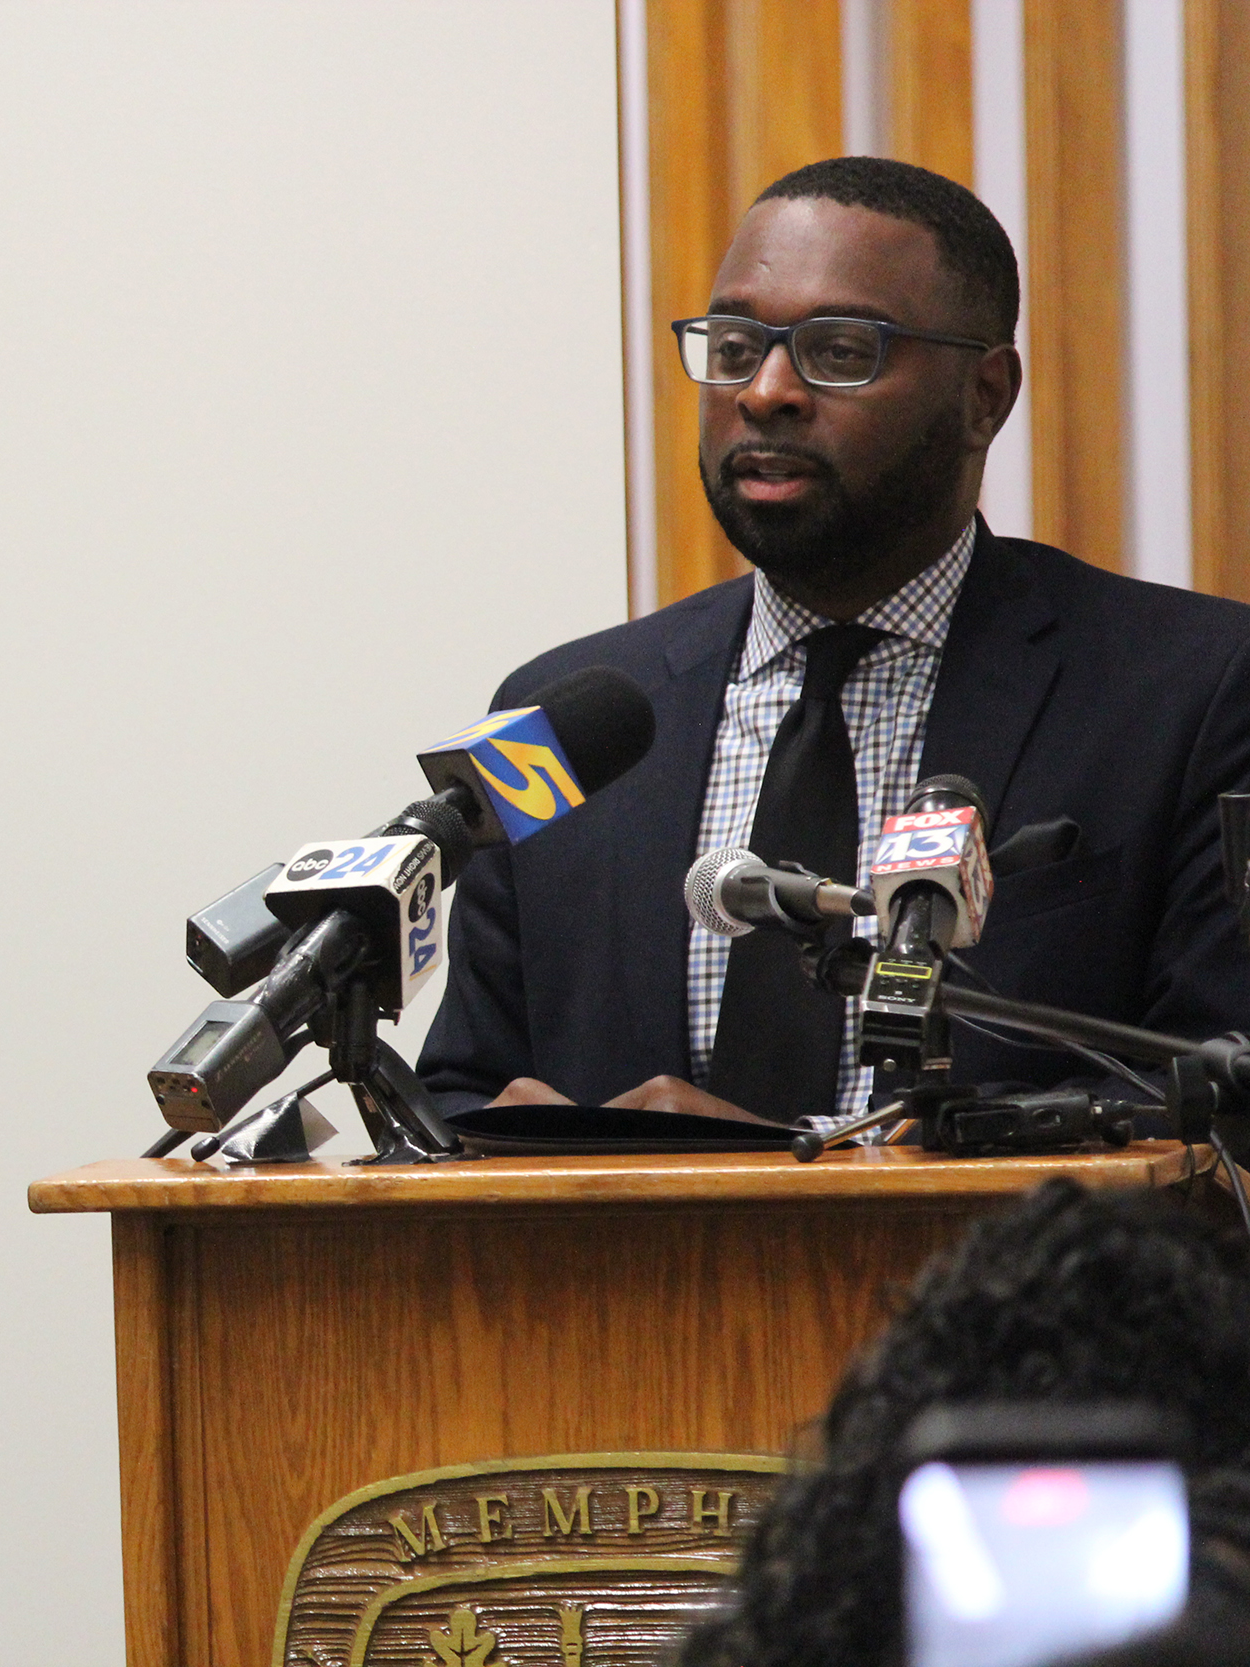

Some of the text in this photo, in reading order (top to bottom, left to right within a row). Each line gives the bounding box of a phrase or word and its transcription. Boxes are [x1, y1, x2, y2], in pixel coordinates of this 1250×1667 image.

[469, 738, 586, 820] 5
[894, 810, 964, 831] FOX
[888, 827, 958, 862] 13
[318, 843, 397, 880] 24
[403, 857, 421, 877] RIGHT
[877, 856, 955, 872] NEWS
[393, 873, 407, 890] NOW
[408, 907, 437, 976] 24
[878, 995, 916, 1003] SONY
[387, 1486, 734, 1563] MEMPH
